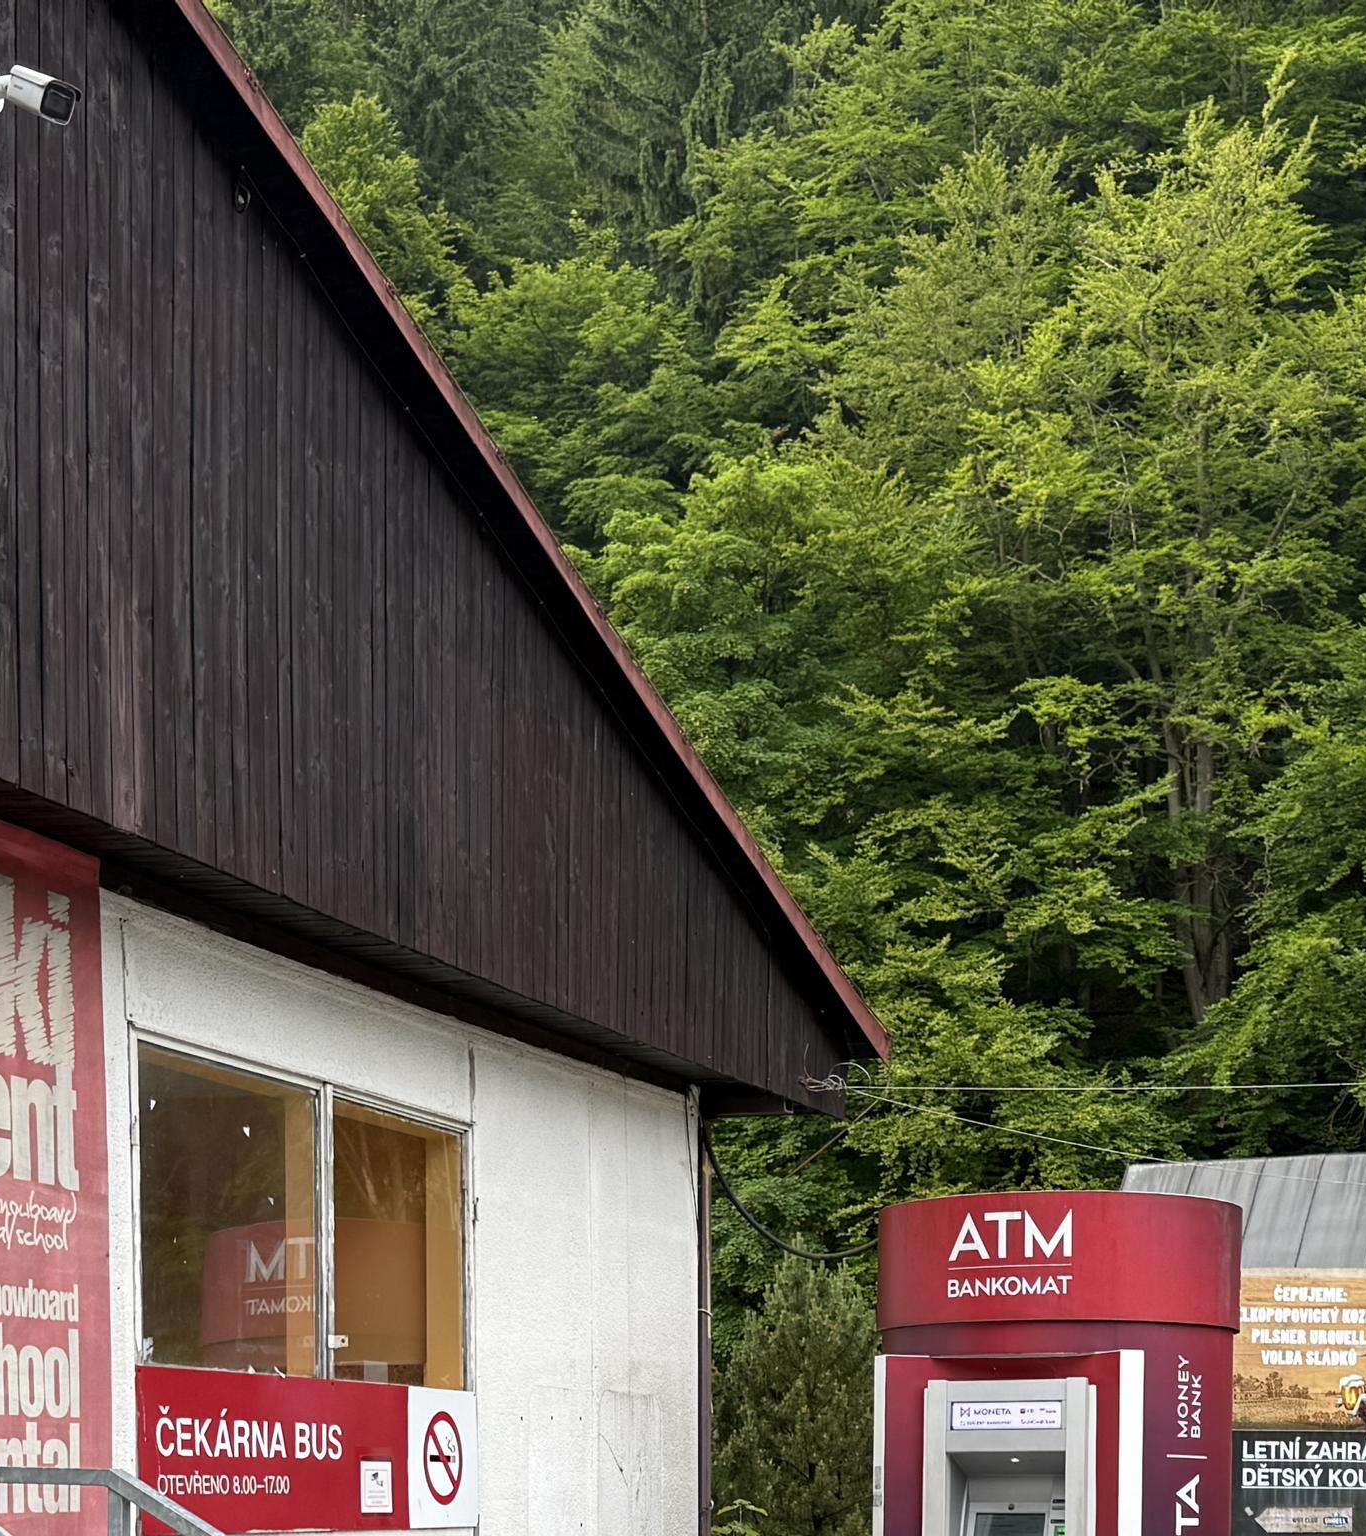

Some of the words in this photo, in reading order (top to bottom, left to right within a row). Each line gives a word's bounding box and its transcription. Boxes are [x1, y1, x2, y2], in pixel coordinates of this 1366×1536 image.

[947, 1208, 1073, 1262] ATM
[946, 1275, 1074, 1299] BANKOMAT
[1273, 1284, 1349, 1303] ČEPUJEME:
[1251, 1328, 1307, 1344] PILSNER
[1260, 1349, 1303, 1365] VOLBA
[1305, 1347, 1359, 1366] SLÁDKŮ
[1176, 1354, 1190, 1438] MONEY
[1190, 1374, 1202, 1439] BANK
[973, 1407, 1012, 1416] MONETA
[155, 1405, 287, 1459] ČEKÁRNA
[294, 1422, 343, 1461] BUS
[1242, 1437, 1301, 1460] LETNÍ
[156, 1470, 230, 1497] OTEVŘENO
[1241, 1463, 1322, 1487] DĚTSKÝ
